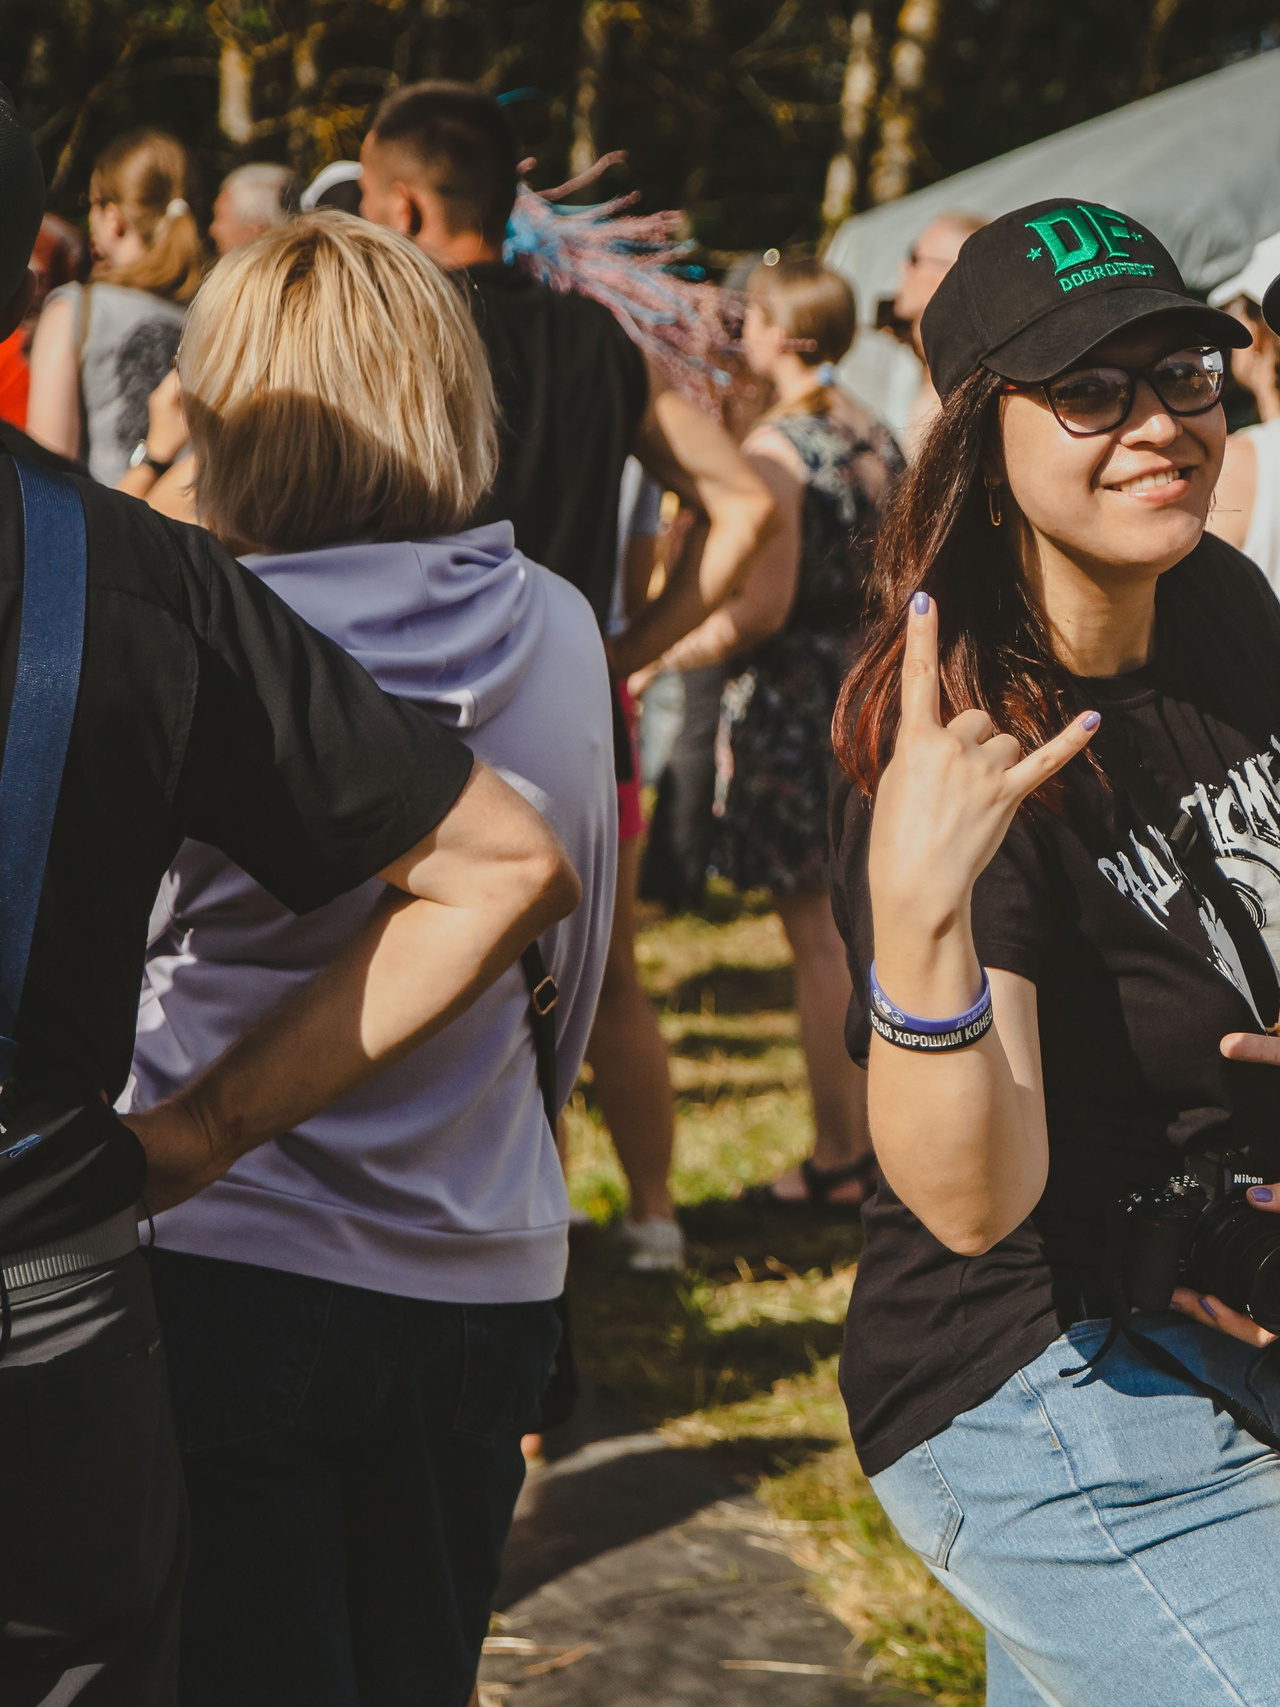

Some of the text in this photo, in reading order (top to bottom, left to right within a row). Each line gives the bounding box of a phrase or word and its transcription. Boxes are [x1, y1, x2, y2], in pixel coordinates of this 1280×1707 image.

[1025, 204, 1130, 276] DF
[1058, 261, 1155, 293] DOBROFEST
[894, 1030, 962, 1047] ХОРОШИМ
[1233, 1173, 1264, 1185] Nikon
